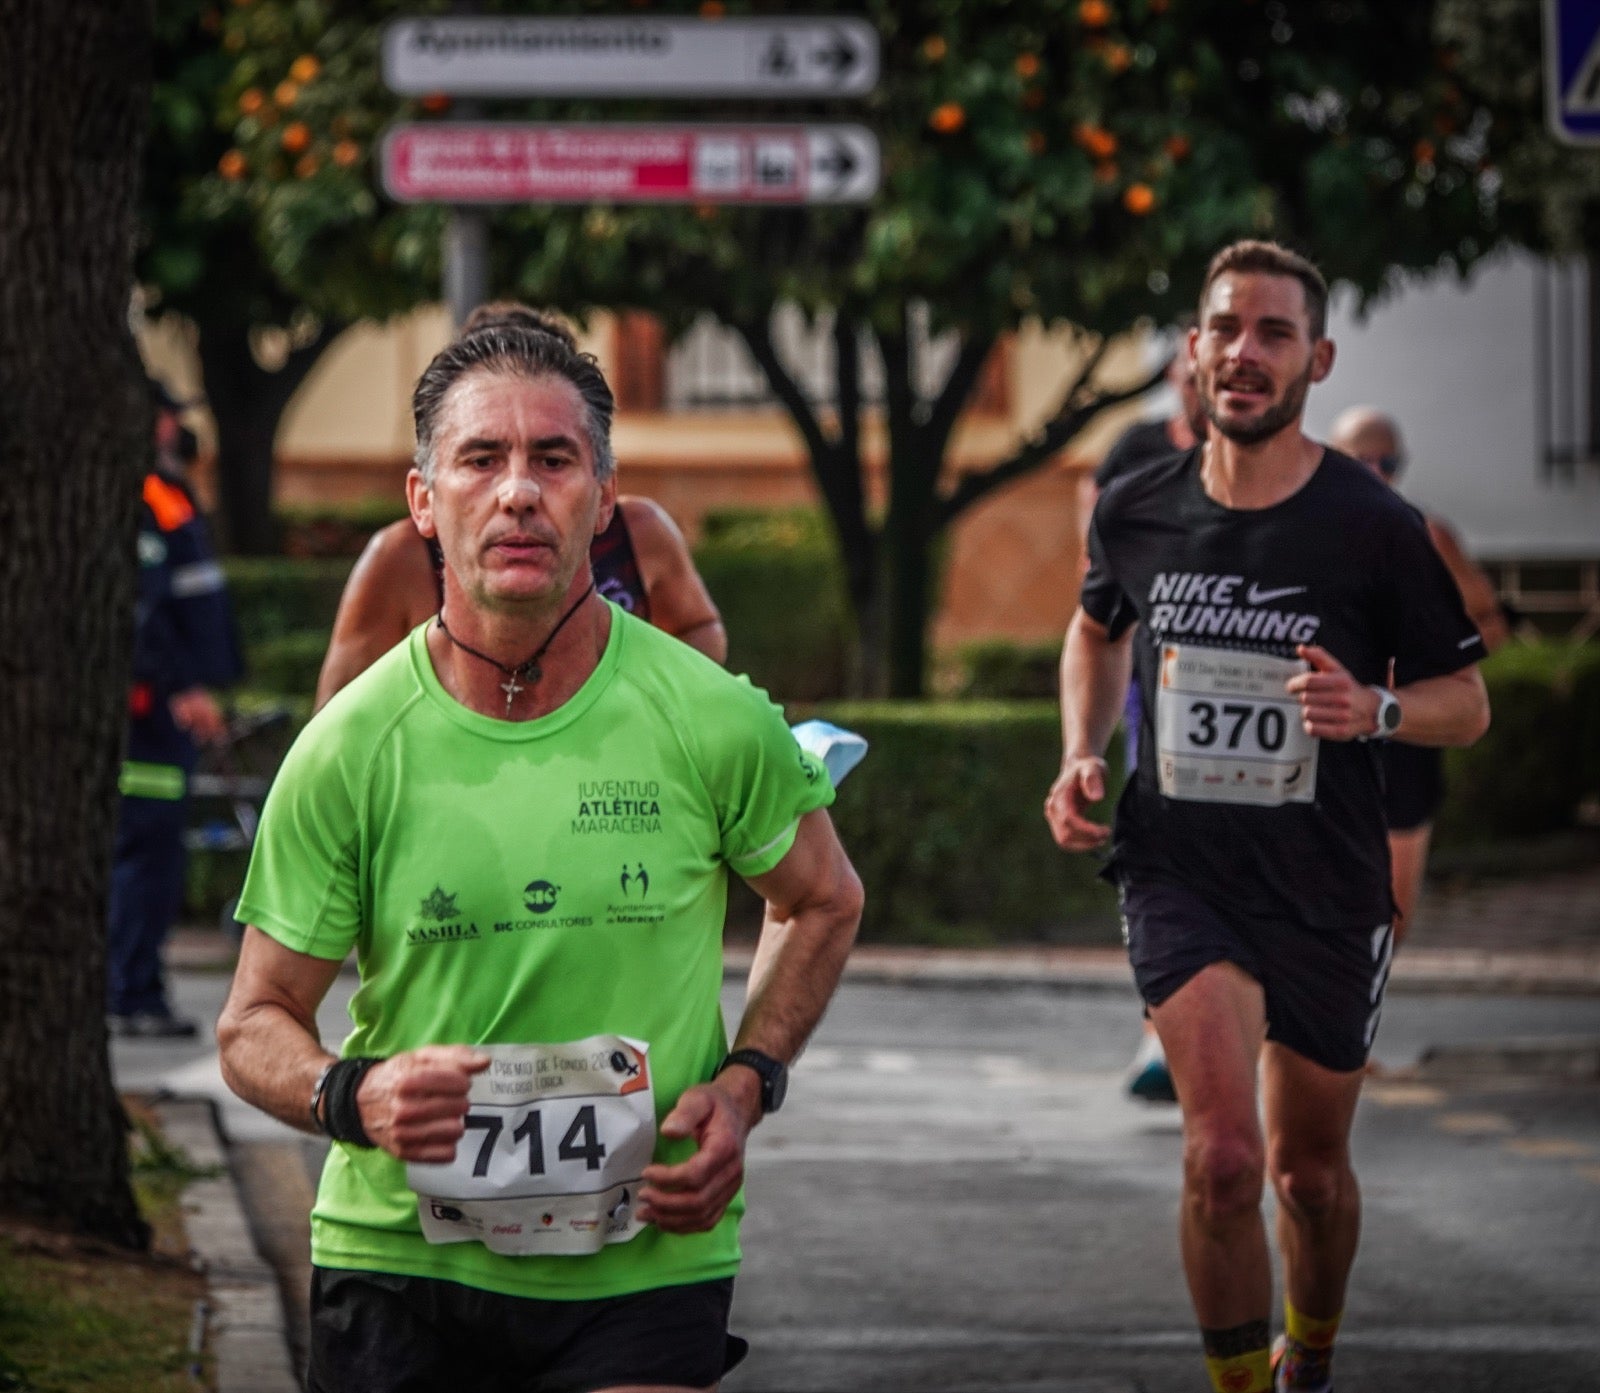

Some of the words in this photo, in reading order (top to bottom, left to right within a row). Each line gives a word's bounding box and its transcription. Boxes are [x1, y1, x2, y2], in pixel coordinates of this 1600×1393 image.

[1149, 572, 1244, 605] NIKE
[1149, 603, 1321, 643] RUNNING
[1187, 701, 1288, 753] 370
[577, 780, 660, 800] JUVENTUD
[579, 796, 661, 816] ATLÉTICA
[571, 818, 662, 835] MARACENA
[493, 921, 513, 933] SIC
[515, 915, 593, 930] CONSULTORES
[494, 1059, 533, 1075] PREMIO
[552, 1055, 588, 1072] FONDO
[464, 1104, 606, 1177] 714
